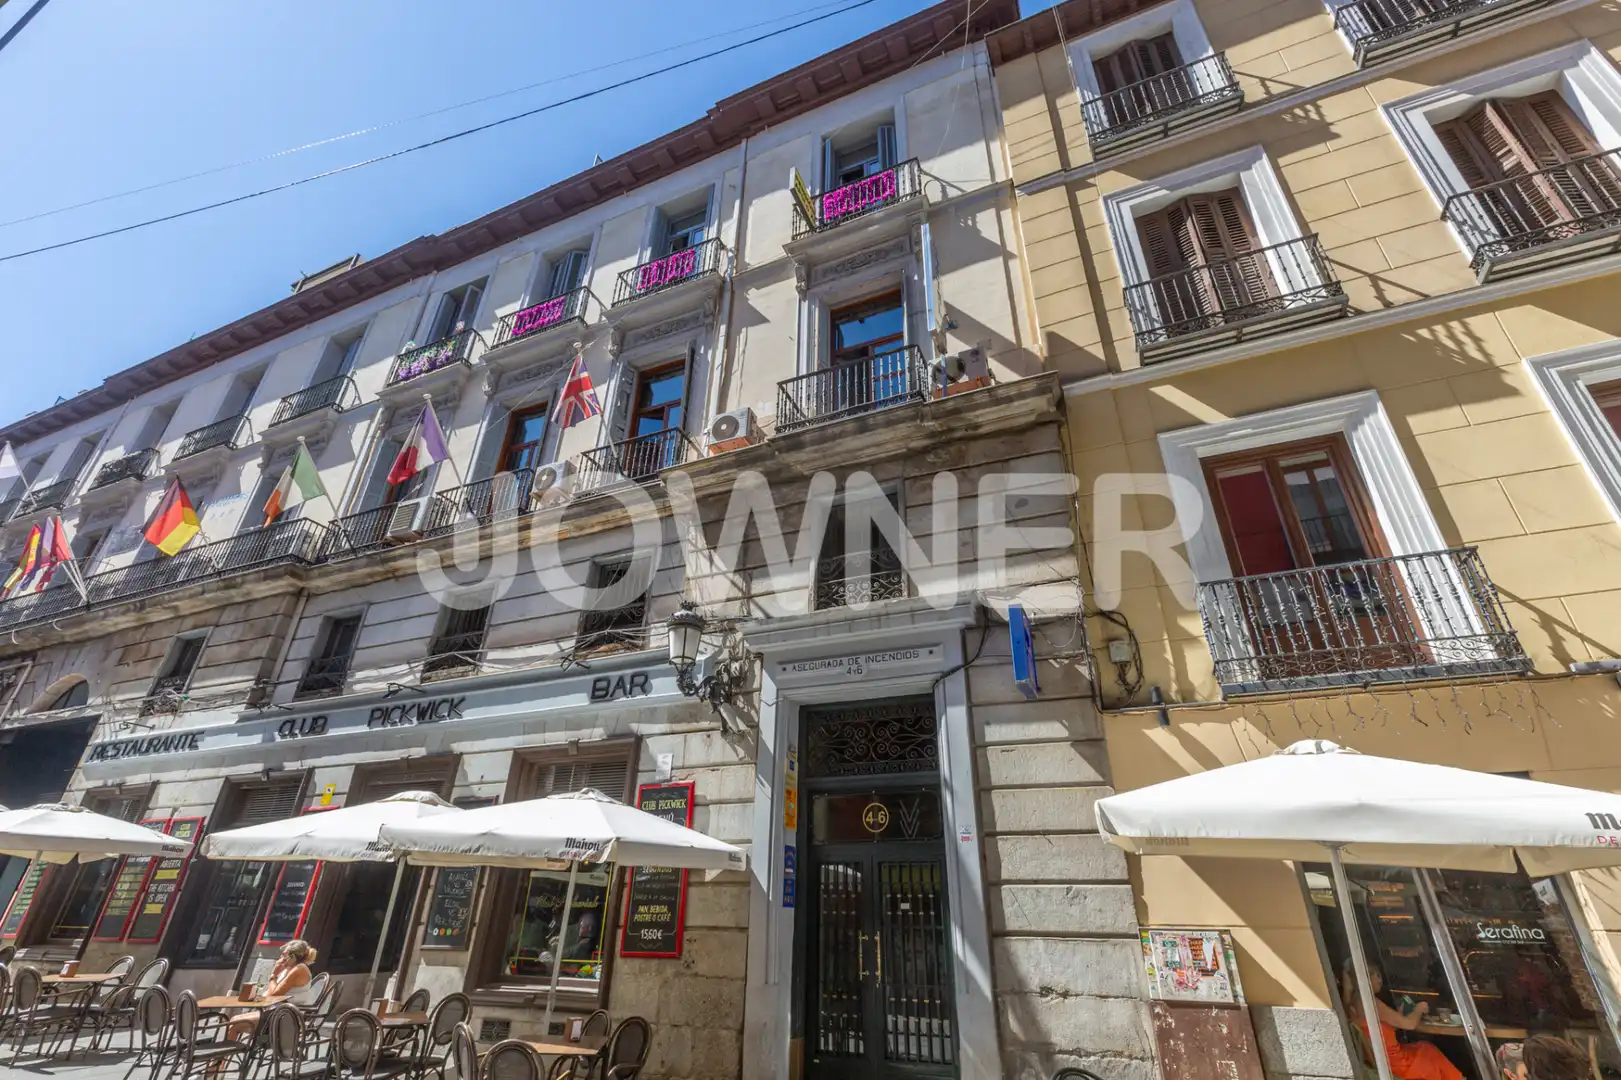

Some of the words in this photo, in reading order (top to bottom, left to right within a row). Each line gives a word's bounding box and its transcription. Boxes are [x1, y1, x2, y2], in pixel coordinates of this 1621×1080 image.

[791, 658, 844, 672] ASEGURADA
[847, 656, 861, 666] DE
[865, 649, 919, 664] INCENDIOS
[89, 731, 205, 762] RESTAURANTE
[278, 715, 328, 739] CLUB
[367, 696, 467, 728] PICKWICK
[590, 671, 650, 701] BAR
[641, 800, 657, 811] CLUB
[658, 798, 687, 810] PICKWICK
[1476, 922, 1546, 940] Serafina
